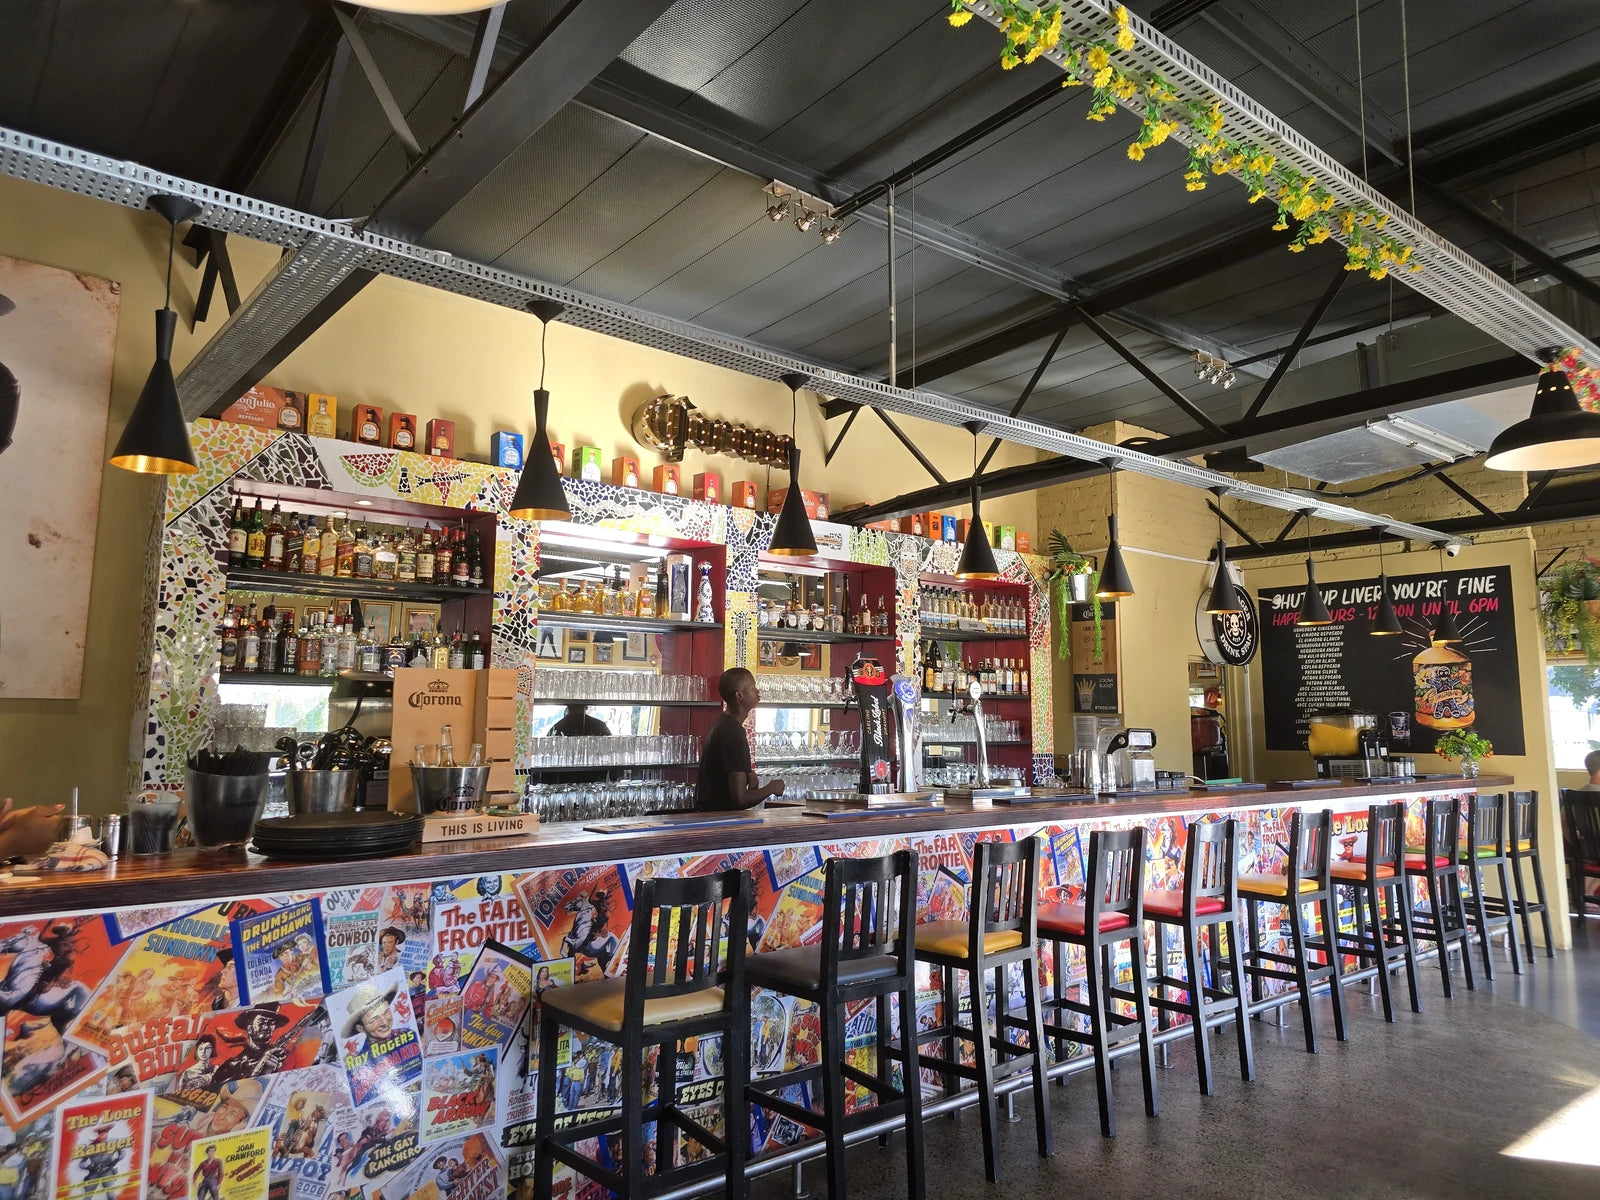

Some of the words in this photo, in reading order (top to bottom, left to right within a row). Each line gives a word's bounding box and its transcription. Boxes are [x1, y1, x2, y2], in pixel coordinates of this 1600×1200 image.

[1319, 589, 1338, 606] UP
[1341, 585, 1382, 605] LIVER
[1457, 575, 1497, 596] FINE
[1272, 611, 1301, 627] HAPP
[1329, 607, 1356, 622] URS
[1469, 597, 1499, 613] 6PM
[1220, 634, 1240, 658] DRINK
[408, 691, 463, 710] Corona
[870, 695, 882, 720] Label
[873, 719, 884, 747] Black
[441, 823, 467, 837] THIS
[473, 822, 483, 834] IS
[488, 819, 524, 832] LIVING
[914, 839, 933, 854] The
[933, 836, 957, 852] FAR
[920, 852, 964, 871] RONTIE
[441, 905, 477, 927] The
[479, 899, 521, 922] FAR
[534, 879, 568, 928] LONE
[242, 911, 288, 942] DRUMS
[288, 904, 312, 920] ALONG
[246, 941, 261, 953] THE
[261, 912, 312, 947] MOHAWK
[144, 934, 218, 963] SUNDOWN
[328, 929, 378, 948] COWBOY
[247, 955, 273, 970] COLBERT
[250, 967, 273, 979] FONDA
[468, 1013, 487, 1031] The
[485, 1023, 504, 1040] Gay
[134, 1043, 186, 1083] Bill
[427, 1089, 482, 1112] BLACK
[680, 1080, 714, 1104] EYES
[66, 1114, 99, 1131] The
[101, 1105, 143, 1124] Lone
[431, 1101, 491, 1126] ARROW
[72, 1135, 134, 1160] Ranger
[225, 1148, 266, 1163] CRAWFORD
[236, 1143, 255, 1153] JOAN
[369, 1146, 422, 1174] RANCHERO
[374, 1145, 392, 1160] THE
[393, 1136, 416, 1151] GAY
[297, 1181, 326, 1195] 2008
